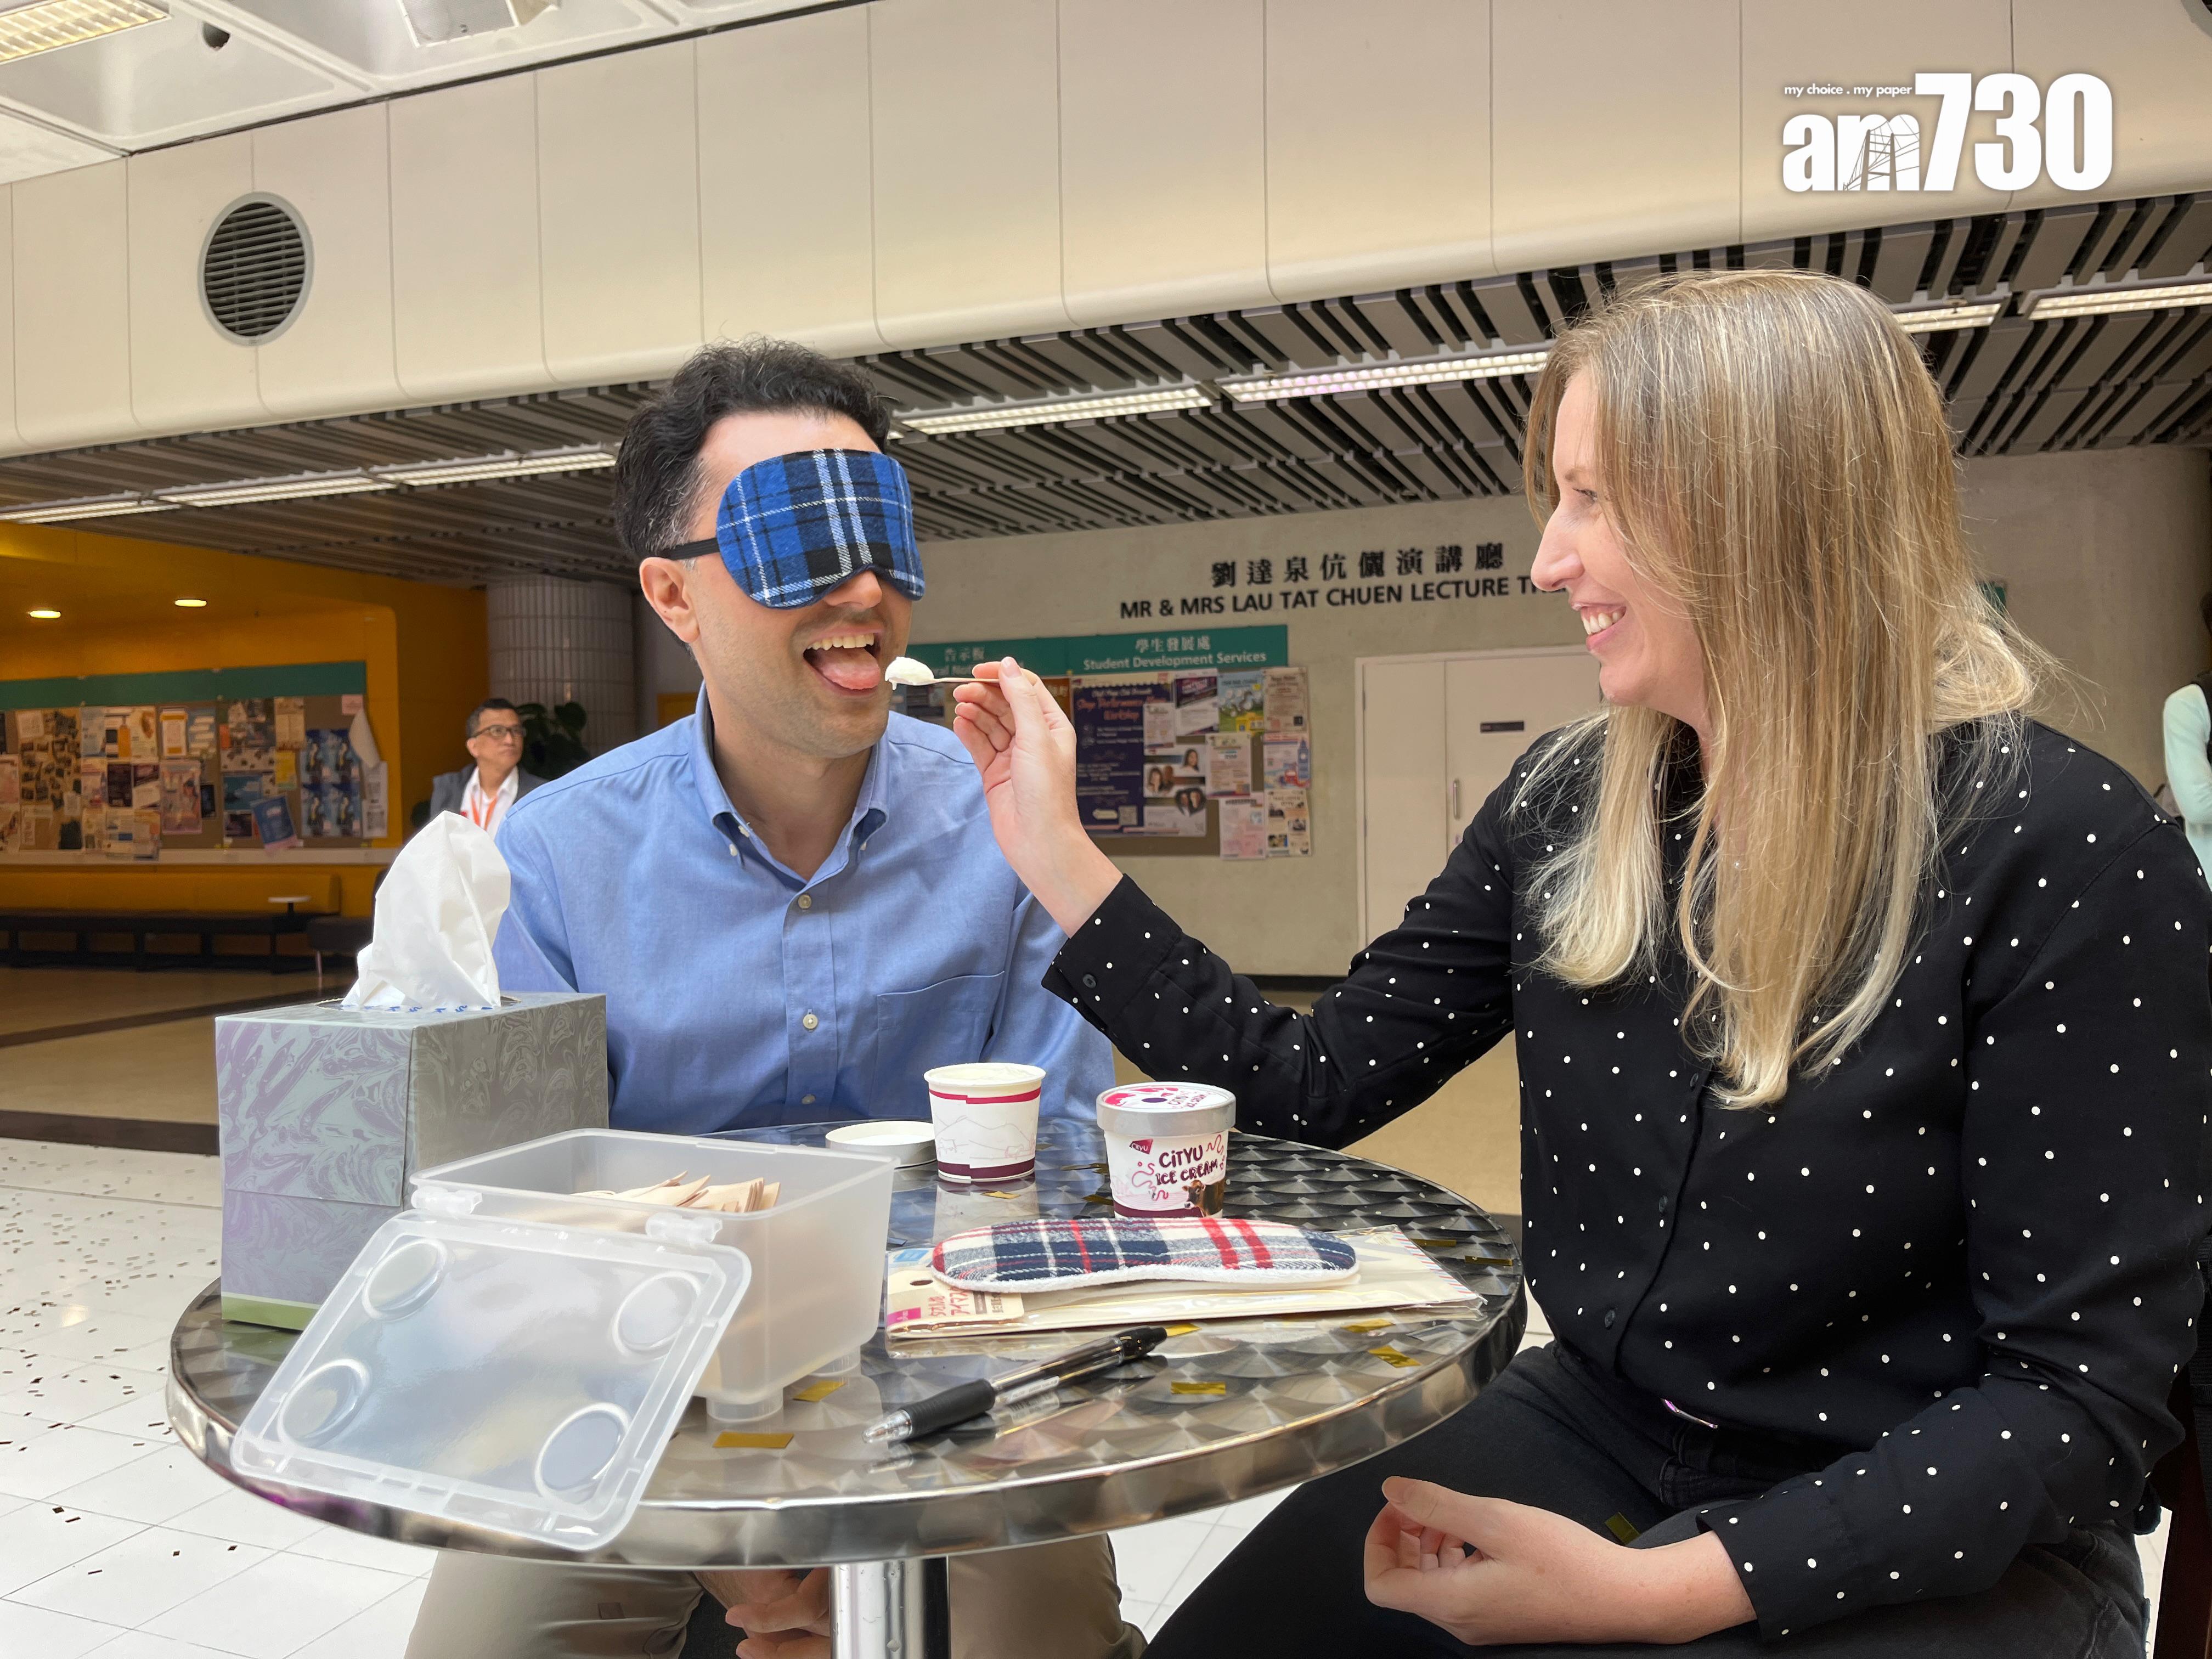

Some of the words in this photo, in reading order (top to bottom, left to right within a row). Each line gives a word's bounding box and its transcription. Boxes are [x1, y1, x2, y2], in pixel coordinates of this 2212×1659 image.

[1120, 601, 1152, 618] MR
[1159, 599, 1174, 617] &
[1180, 596, 1224, 615] MRS
[1232, 592, 1272, 613] LAU
[1279, 589, 1319, 609] TAT
[1326, 584, 1402, 606] CHUEN
[1410, 576, 1509, 602] LECTURE
[1084, 658, 1130, 670] Student
[1133, 654, 1213, 669] Development
[1216, 650, 1267, 664] Services
[1155, 1170, 1177, 1185] ICE
[1180, 1159, 1218, 1181] CREAM
